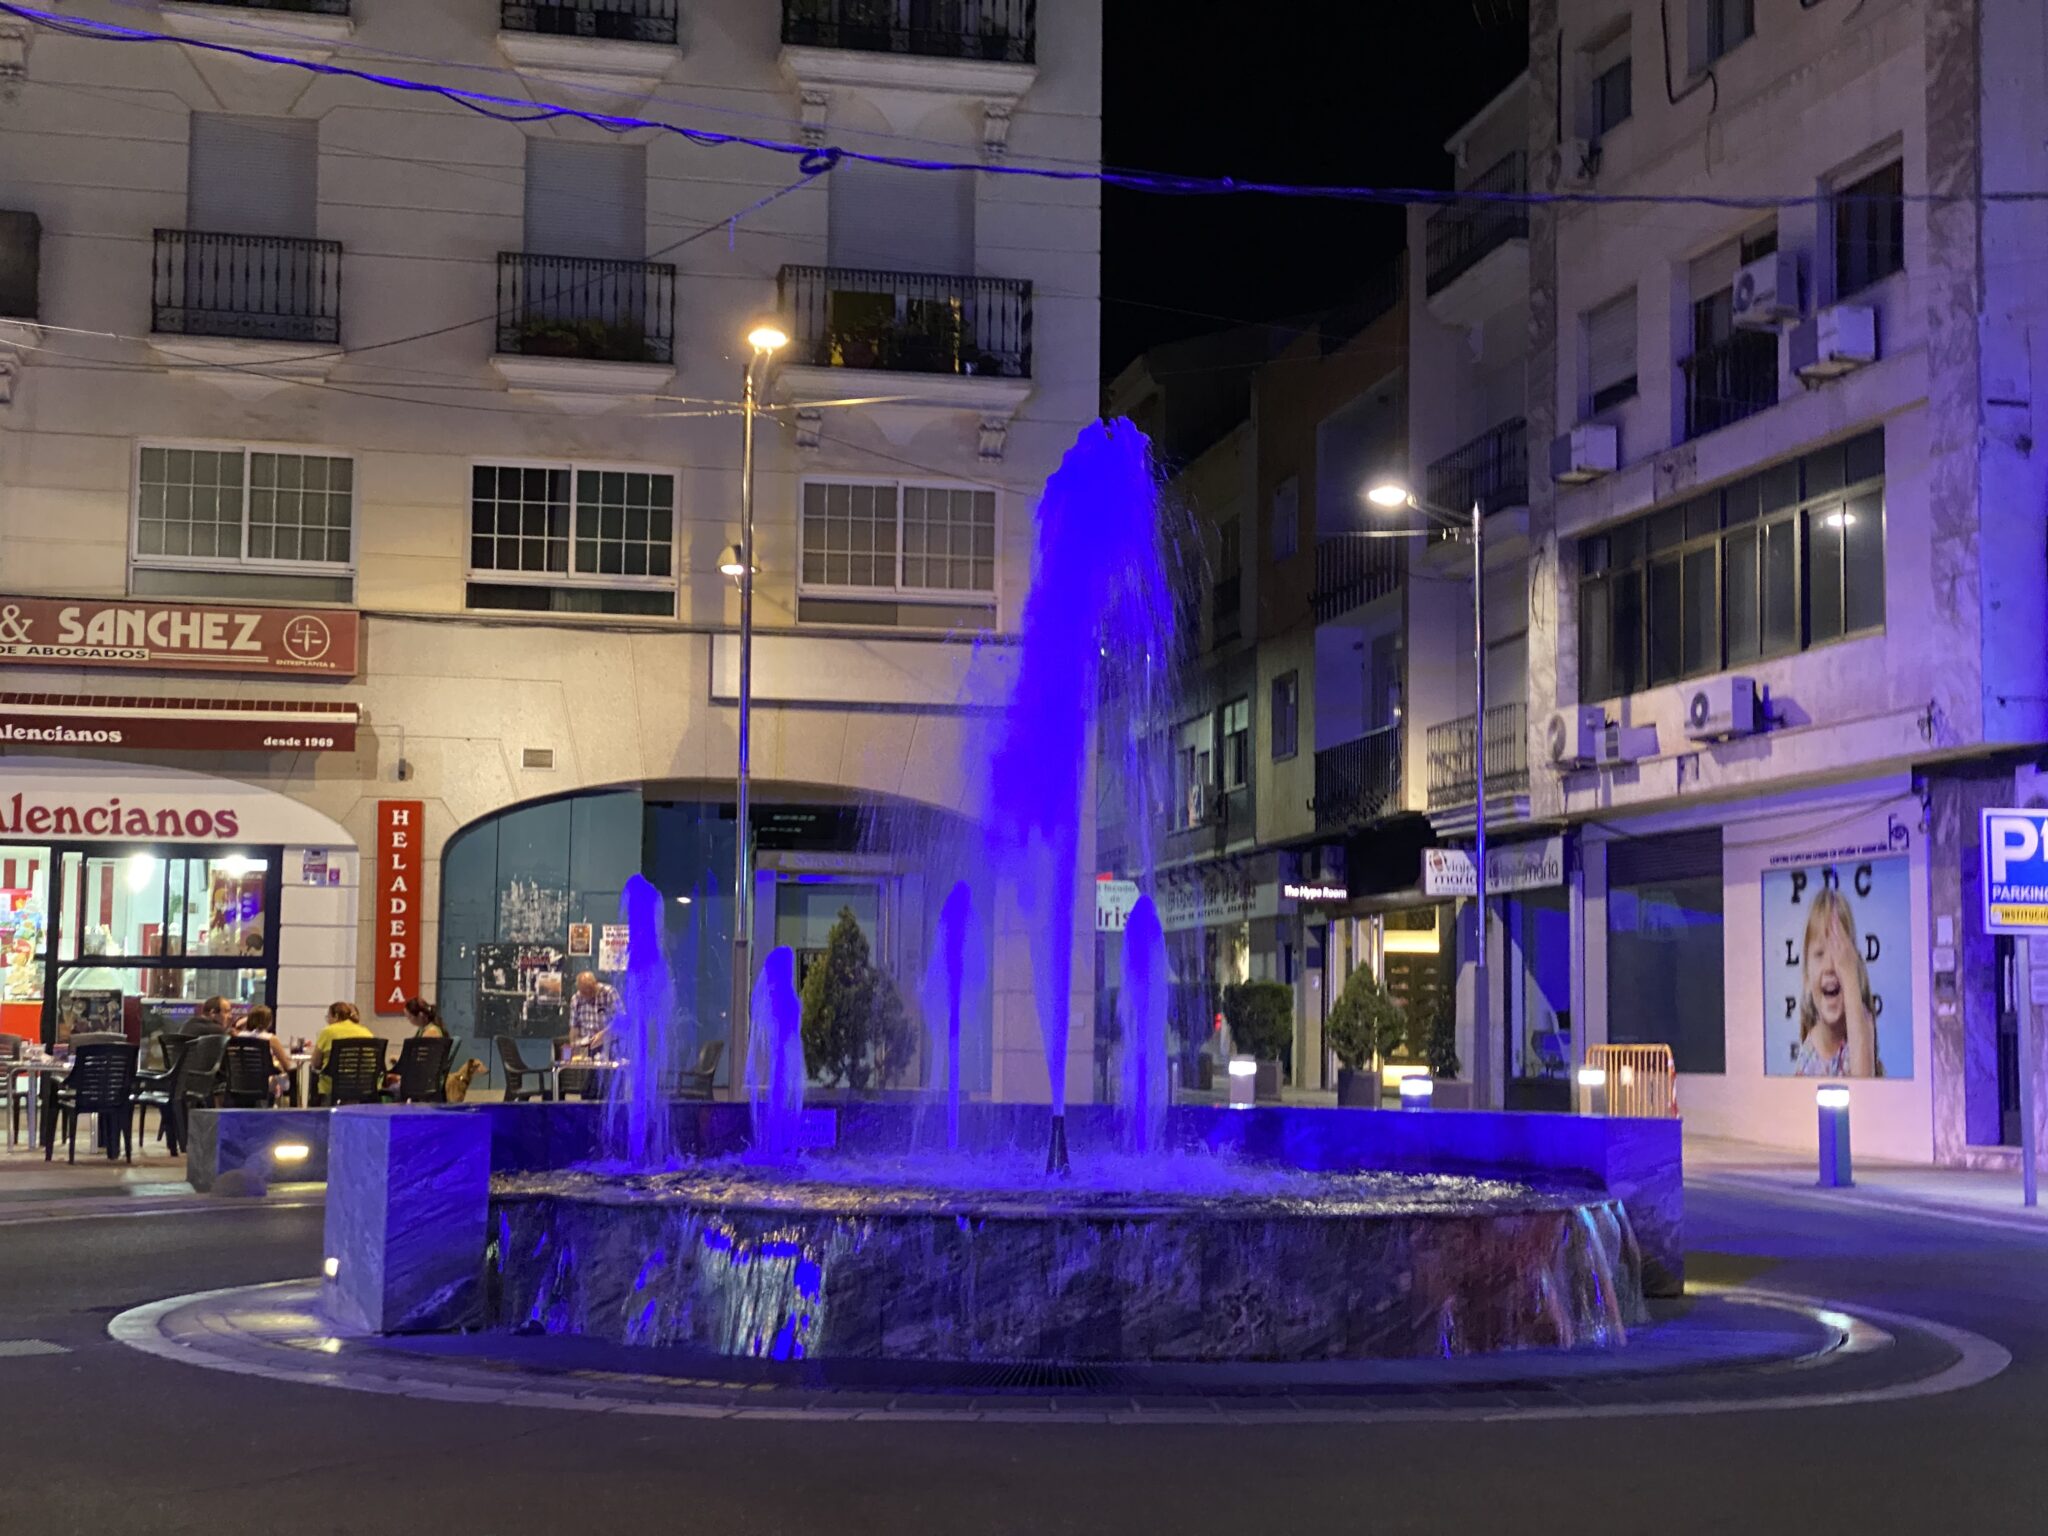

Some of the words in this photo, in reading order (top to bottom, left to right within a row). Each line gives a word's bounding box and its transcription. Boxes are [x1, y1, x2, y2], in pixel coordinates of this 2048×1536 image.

[0, 604, 33, 643] &
[58, 606, 262, 651] SANCHEZ
[27, 646, 146, 659] ABOGADOS
[263, 736, 301, 747] desde
[304, 736, 334, 747] 1969
[1991, 817, 2039, 883] P
[1284, 885, 1299, 897] The
[1323, 886, 1347, 899] Room
[1791, 870, 1807, 903] P
[1855, 863, 1872, 897] C
[388, 809, 409, 1004] HELADERÍA
[1786, 941, 1799, 965] L
[1866, 936, 1880, 962] D
[1785, 998, 1796, 1018] P
